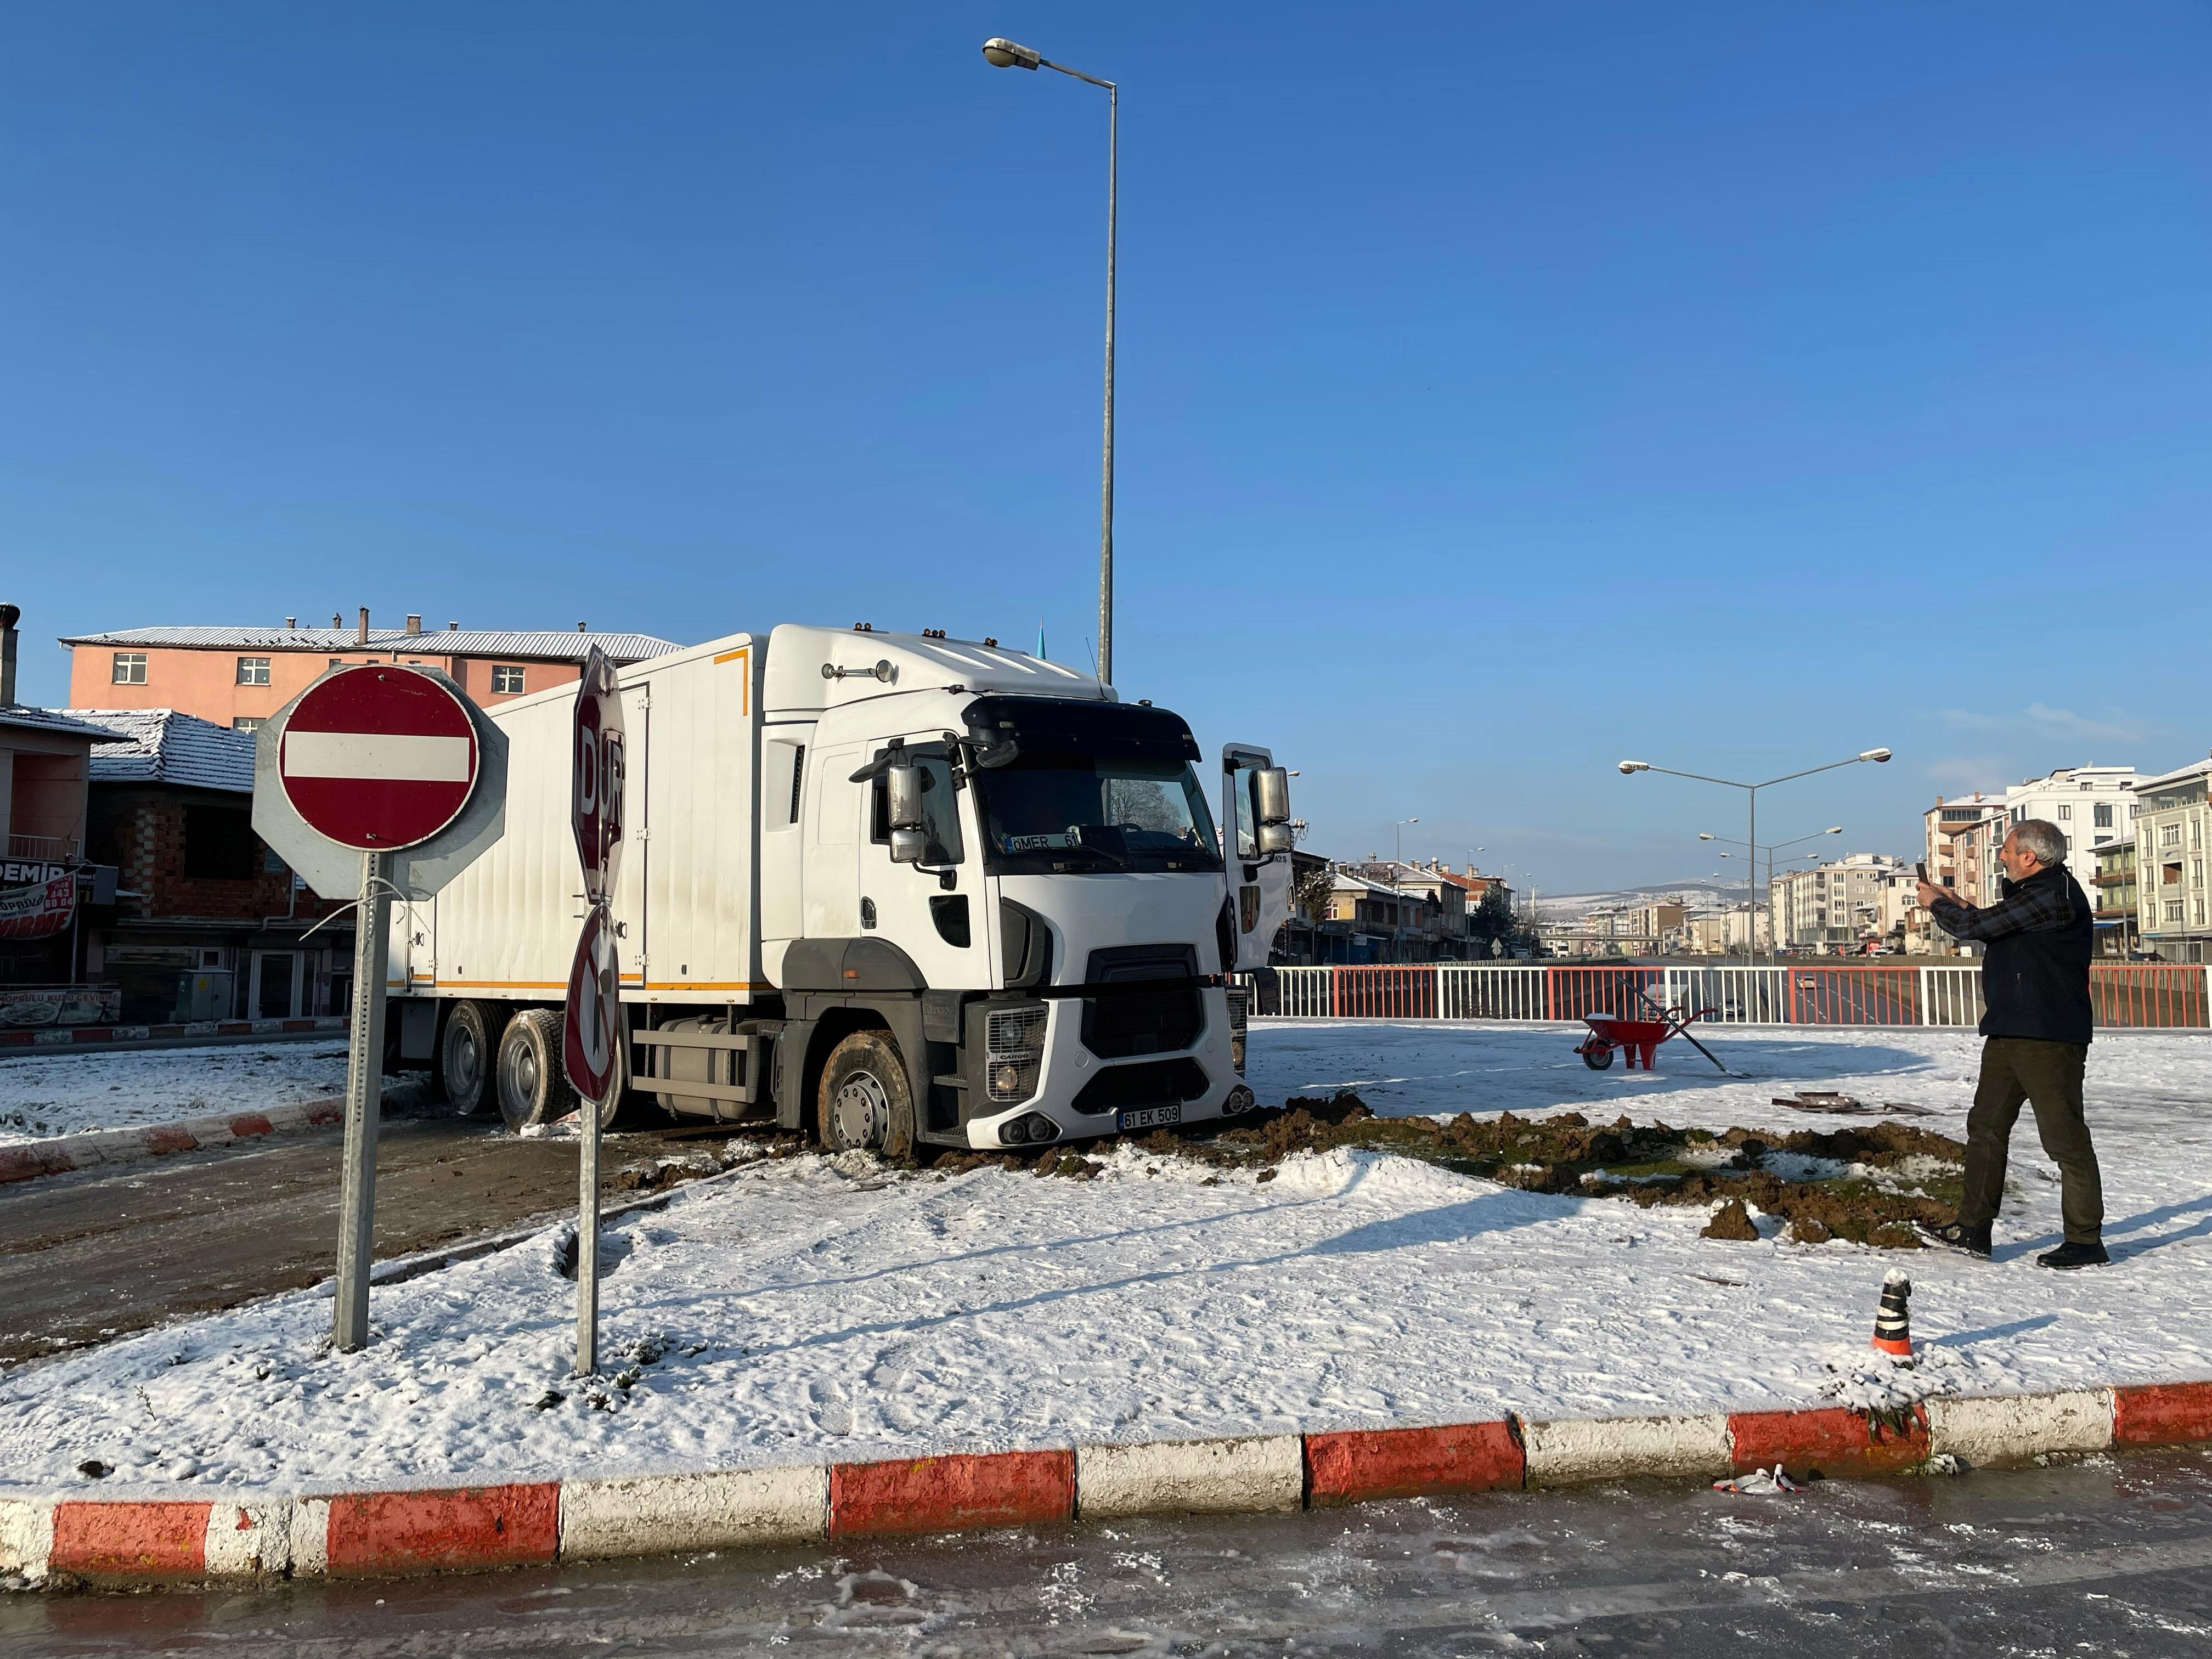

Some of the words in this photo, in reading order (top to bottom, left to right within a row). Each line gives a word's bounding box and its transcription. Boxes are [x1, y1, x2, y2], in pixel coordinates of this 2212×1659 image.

[581, 725, 622, 827] DUR
[1013, 836, 1049, 851] ÖMER
[1064, 834, 1078, 847] 61
[1125, 1113, 1136, 1127] 61
[1140, 1110, 1154, 1125] EK
[1158, 1107, 1178, 1122] 509
